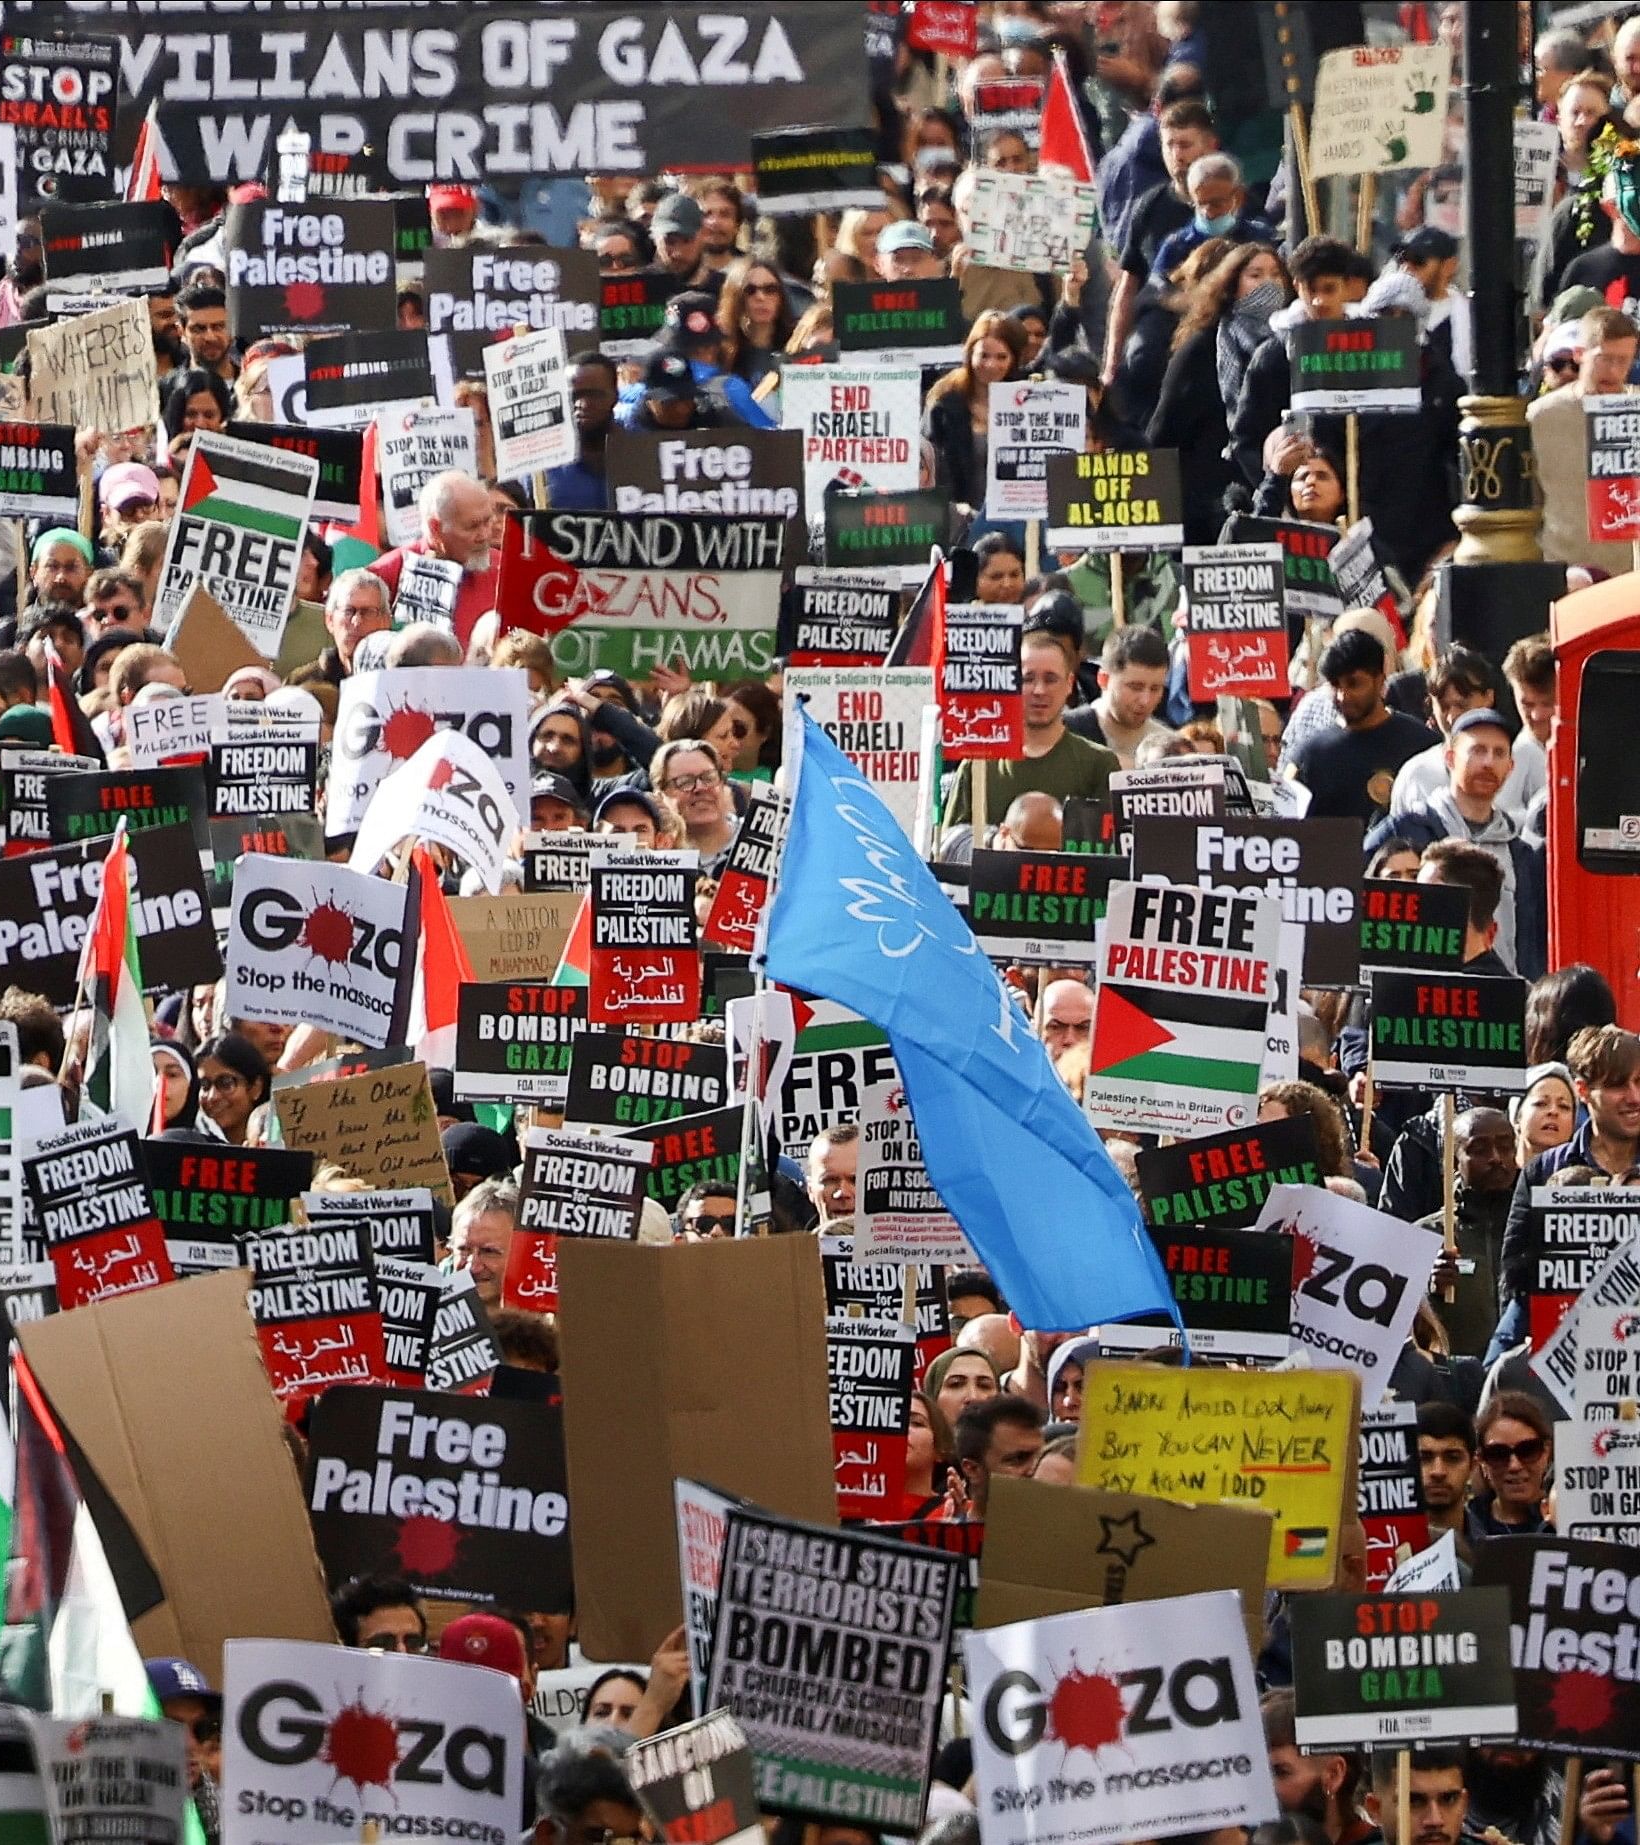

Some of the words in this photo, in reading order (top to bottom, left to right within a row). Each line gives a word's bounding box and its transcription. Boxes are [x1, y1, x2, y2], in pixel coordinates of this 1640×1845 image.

[118, 30, 459, 98] VILIANS
[482, 18, 577, 88] OF
[600, 16, 804, 84] GAZA
[4, 65, 114, 104] STOP
[198, 115, 366, 180] WR
[387, 101, 646, 180] CRIME
[33, 150, 104, 175] GAZA
[263, 212, 345, 246] Free
[229, 248, 388, 286] Palestine
[473, 258, 556, 290] Free
[429, 295, 597, 331] Palestine
[811, 413, 890, 437] ISRAELI
[1077, 452, 1149, 477] HANDS
[1093, 479, 1131, 501] OFF
[1068, 500, 1159, 525] AL-AQSA
[172, 522, 296, 588] FREE
[520, 522, 534, 558] I
[552, 517, 686, 566] STAND
[695, 519, 785, 566] WITH
[1193, 566, 1274, 592] FREEDOM
[533, 574, 728, 623] GAZANS,
[802, 590, 888, 619] FREEDOM
[1190, 601, 1280, 630] PALESTINE
[631, 631, 774, 670] HAMAS
[797, 623, 891, 653] PALESTINE
[1206, 638, 1267, 659] الحرية
[1202, 661, 1275, 687] لفلسطين
[838, 692, 882, 720] END
[948, 701, 1001, 720] الحرية
[943, 722, 1010, 745] لفلسطين
[220, 746, 305, 775] FREEDOM
[216, 784, 309, 815] PALESTINE
[541, 836, 585, 848] Socialist
[587, 838, 620, 850] Worker
[1197, 825, 1300, 872] Free
[601, 872, 685, 902] FREEDOM
[508, 908, 559, 930] NATION
[597, 916, 692, 945] PALESTINE
[1131, 889, 1258, 951] FREE
[500, 934, 522, 951] LED
[237, 966, 285, 993] Stop
[293, 970, 324, 992] the
[612, 958, 674, 983] الحرية
[1107, 944, 1268, 995] PALESTINE
[508, 987, 576, 1013] STOP
[604, 984, 686, 1010] لفلسطين
[1417, 987, 1479, 1017] FREE
[620, 1039, 691, 1063] STOP
[1376, 1018, 1520, 1052] PALESTINE
[506, 1044, 570, 1070] GAZA
[330, 1088, 355, 1109] the
[371, 1081, 411, 1103] Olive
[590, 1065, 719, 1101] BOMBING
[615, 1096, 683, 1121] GAZA
[1090, 1090, 1137, 1105] Palestine
[1140, 1096, 1176, 1110] Forum
[1190, 1100, 1223, 1114] Britain
[546, 1134, 596, 1151] Socialist
[597, 1141, 634, 1158] Worker
[1189, 1140, 1264, 1181] FREE
[37, 1140, 133, 1193] FREEDOM
[181, 1155, 256, 1192] FREE
[533, 1155, 634, 1194] FREEDOM
[44, 1189, 150, 1241] PALESTINE
[522, 1197, 633, 1238] PALESTINE
[73, 1235, 138, 1269] الحرية
[253, 1230, 358, 1269] FREEDOM
[248, 1276, 369, 1317] PALESTINE
[273, 1326, 354, 1361] الحرية
[1585, 1348, 1627, 1372] STOP
[274, 1356, 369, 1395] لفلسطين
[379, 1401, 506, 1467] Free
[1101, 1443, 1141, 1461] BUT
[1159, 1437, 1194, 1456] YOU
[1242, 1430, 1331, 1465] NEVER
[1565, 1467, 1610, 1491] STOP
[312, 1459, 567, 1536] Palestine
[740, 1526, 849, 1577] ISRAELI
[857, 1549, 946, 1597] STATE
[730, 1565, 941, 1640] TERRORISTS
[1356, 1601, 1438, 1634] STOP
[728, 1612, 930, 1694] BOMBED
[1326, 1633, 1477, 1669] BOMBING
[1361, 1669, 1443, 1702] GAZA
[984, 1655, 1240, 1759] Gza
[240, 1679, 506, 1798] Gza
[1049, 1772, 1096, 1805] the
[1104, 1751, 1251, 1791] massacre
[992, 1784, 1048, 1812] Stop
[239, 1792, 309, 1823] Stop
[315, 1798, 356, 1826] the
[362, 1804, 504, 1845] massacre
